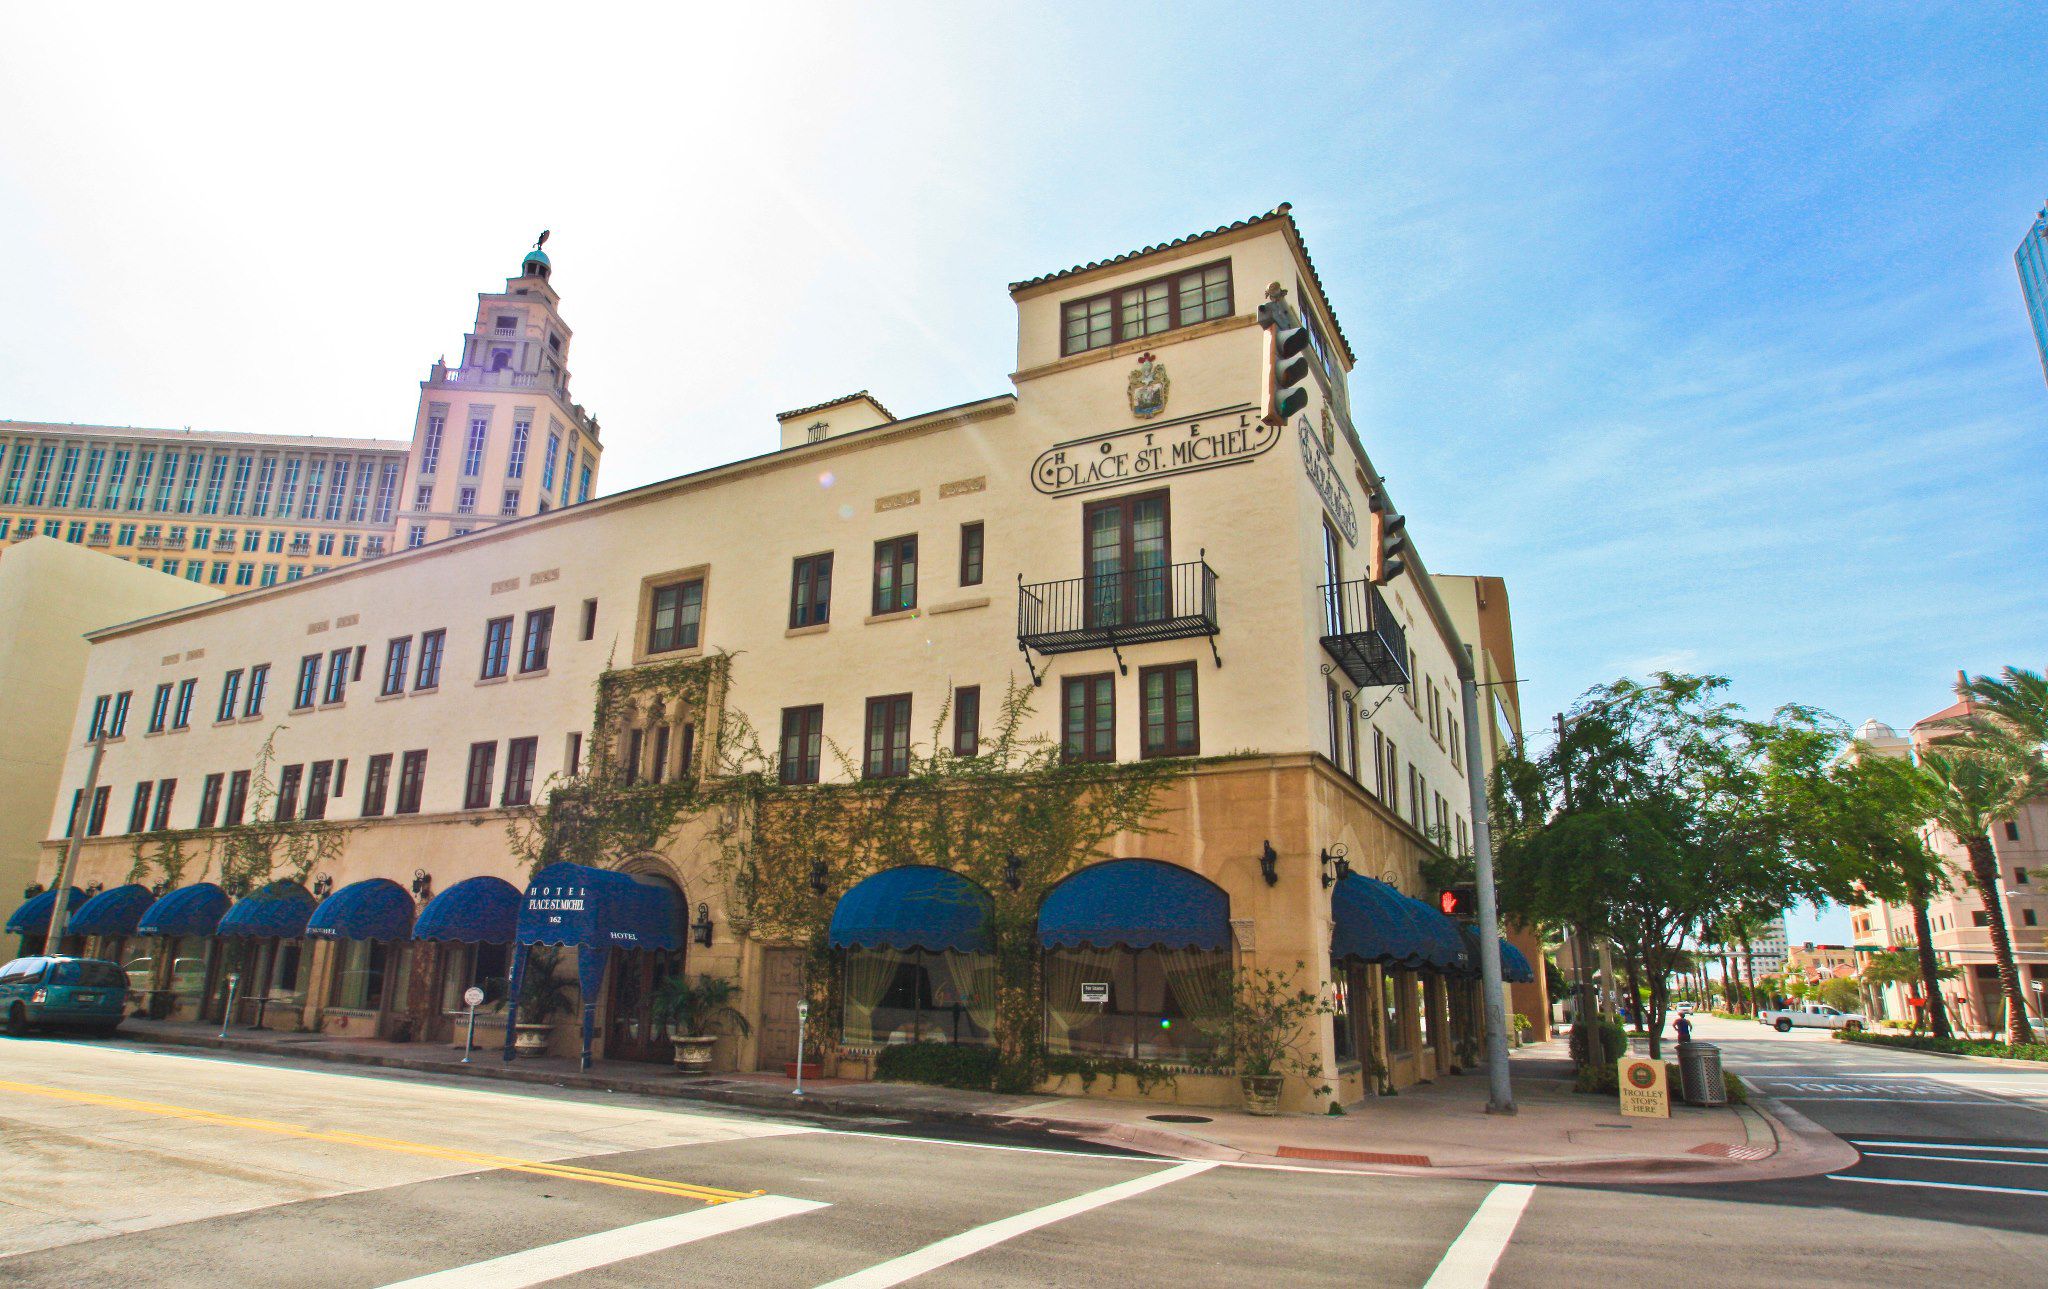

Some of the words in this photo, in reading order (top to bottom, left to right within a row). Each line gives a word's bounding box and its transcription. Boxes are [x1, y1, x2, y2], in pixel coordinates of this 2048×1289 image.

[1054, 414, 1250, 465] HOTEL
[1056, 453, 1129, 489] PLACE
[1134, 447, 1166, 473] ST.
[1172, 429, 1256, 466] MICHEL
[531, 887, 586, 896] HOTEL
[528, 898, 550, 910] PLACE
[561, 899, 585, 911] MICHEL
[550, 916, 562, 924] 162
[610, 931, 638, 941] HOTEL
[1624, 1088, 1663, 1098] TROLLEY
[1631, 1097, 1657, 1105] STOPS
[1633, 1105, 1656, 1113] HERE
